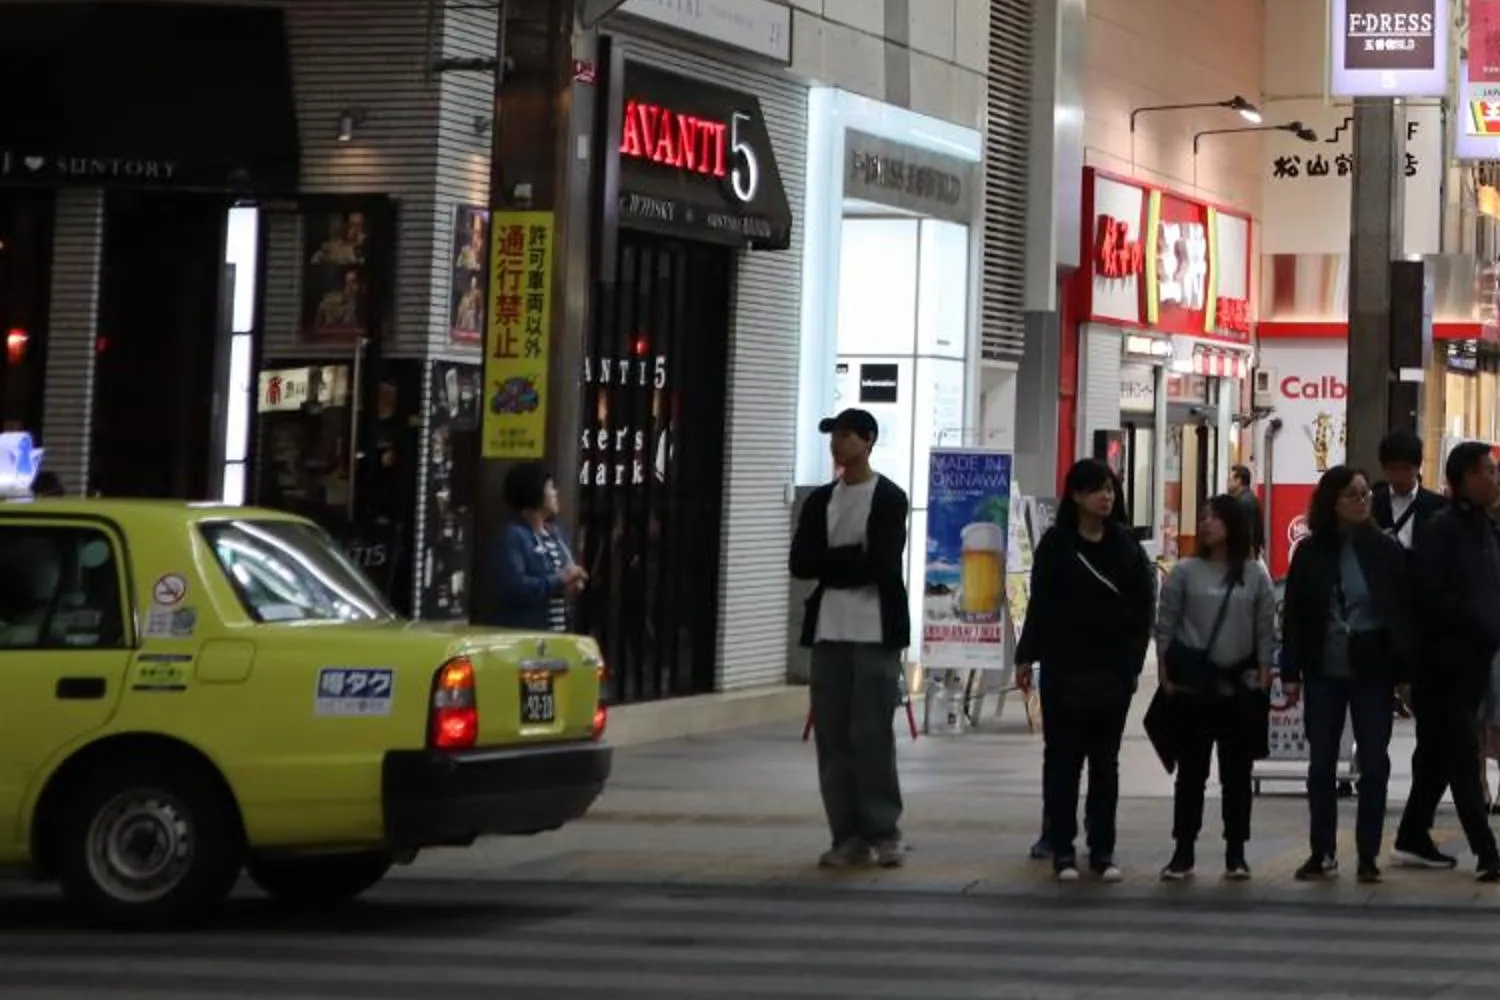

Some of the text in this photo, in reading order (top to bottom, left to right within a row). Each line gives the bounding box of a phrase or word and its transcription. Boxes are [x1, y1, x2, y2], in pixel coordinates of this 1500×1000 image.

[56, 156, 176, 178] SUNTORY
[620, 100, 726, 177] AVANTI
[732, 111, 757, 201] 5
[493, 224, 525, 360] 通行禁止
[524, 225, 547, 359] 許可車両以外
[931, 455, 978, 471] MADE
[933, 472, 1008, 487] OKINAWA
